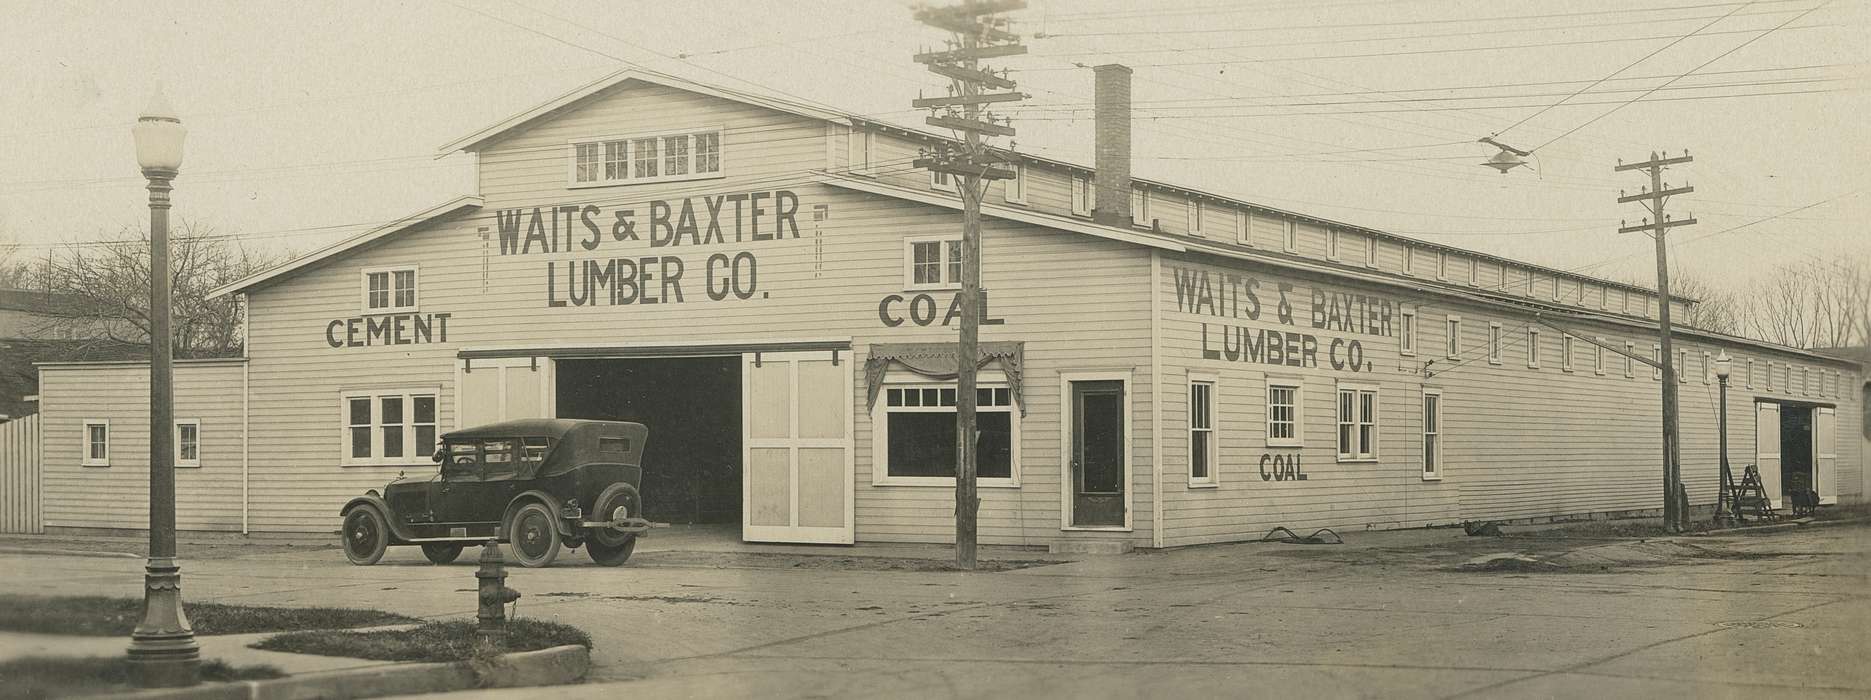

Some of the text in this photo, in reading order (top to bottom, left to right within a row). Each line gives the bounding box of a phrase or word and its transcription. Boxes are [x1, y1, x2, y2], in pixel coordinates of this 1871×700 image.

[496, 190, 801, 256] WAITS & BAXTER
[548, 251, 769, 307] LUMBER CO.
[1173, 266, 1392, 337] WAITS & BAXTER
[326, 314, 452, 348] CEMENT
[879, 291, 1005, 327] COAL
[1202, 322, 1373, 373] LUMBER CO.
[1259, 453, 1308, 481] COAL
